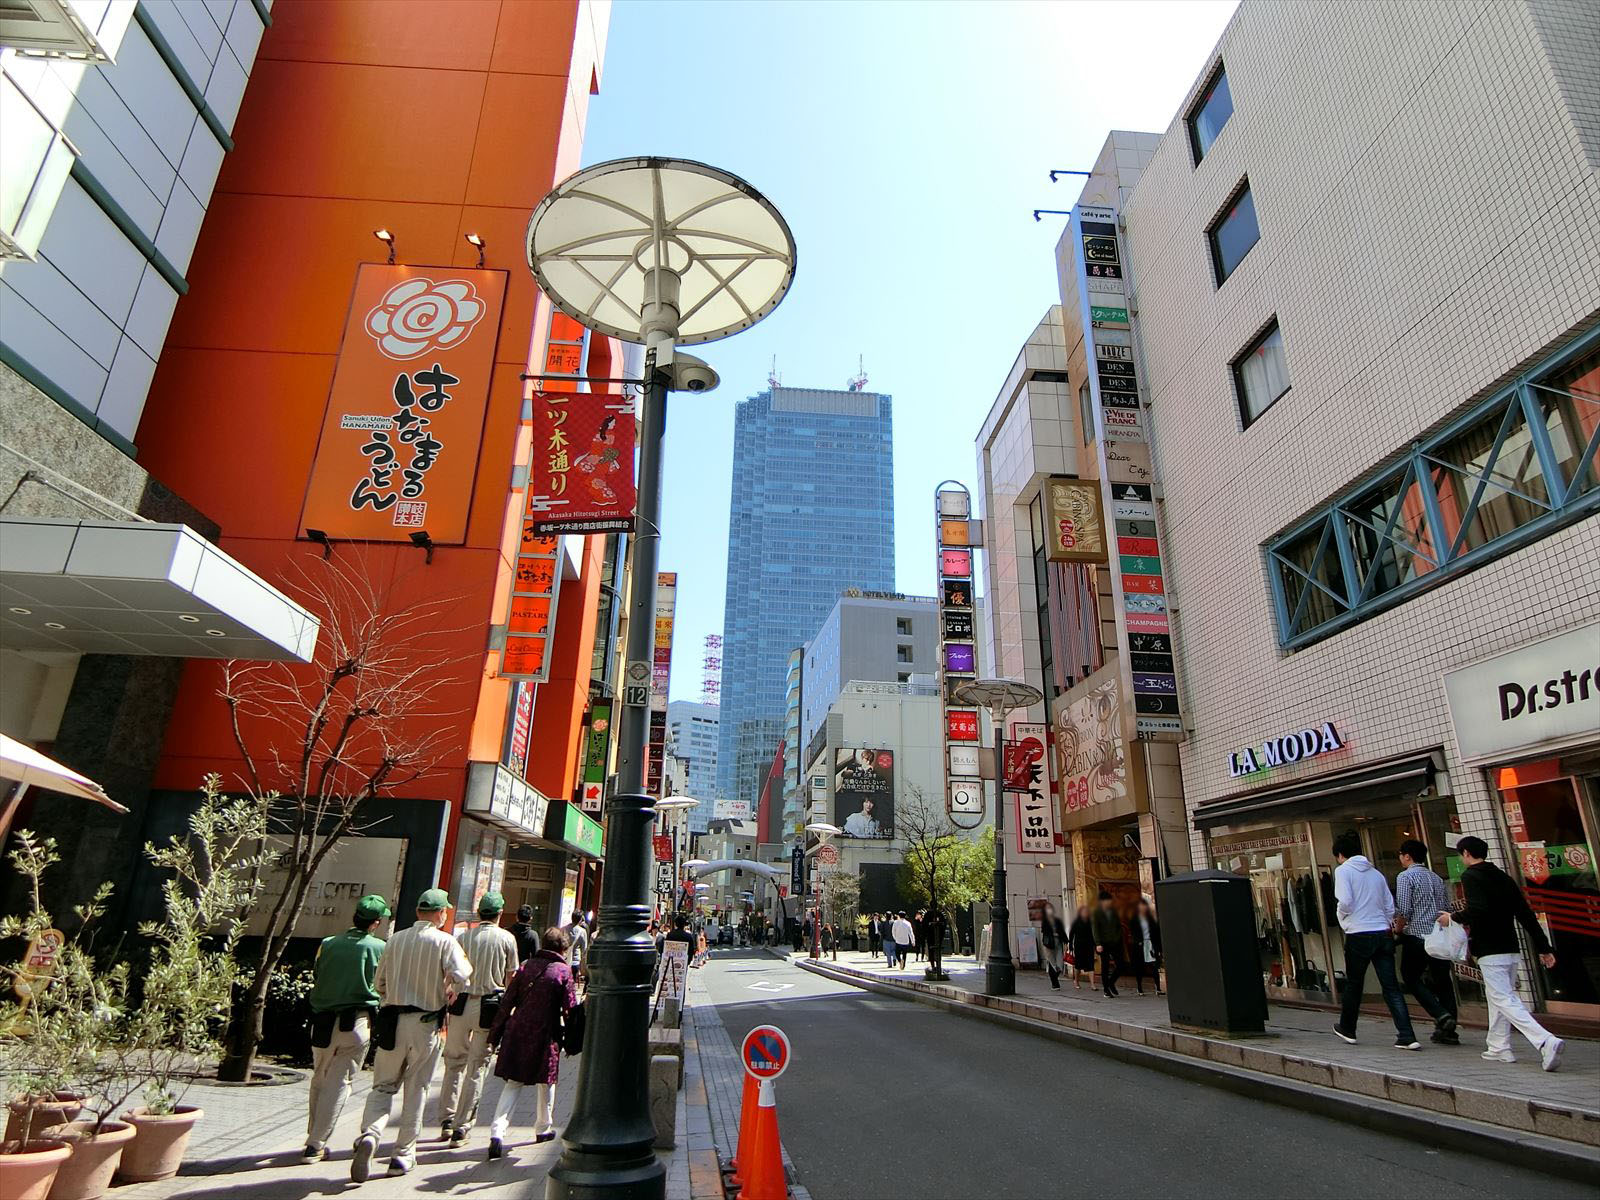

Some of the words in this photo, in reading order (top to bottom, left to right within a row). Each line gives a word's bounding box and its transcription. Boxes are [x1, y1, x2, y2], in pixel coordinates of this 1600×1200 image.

[1109, 379, 1126, 387] DEN
[1107, 416, 1137, 425] FRANCE
[1113, 410, 1125, 418] VIE
[393, 362, 461, 498] はなまる
[546, 398, 570, 496] 一ツ木通り
[351, 431, 400, 511] うどん
[863, 590, 883, 598] HOTEL
[885, 591, 905, 600] VISTA
[951, 592, 965, 605] 優
[629, 687, 646, 704] 12
[1137, 731, 1157, 740] B1F
[1228, 747, 1261, 778] LA
[1263, 722, 1346, 769] MODA
[1025, 764, 1049, 838] 天下一品
[751, 1061, 780, 1069] 駐車禁止
